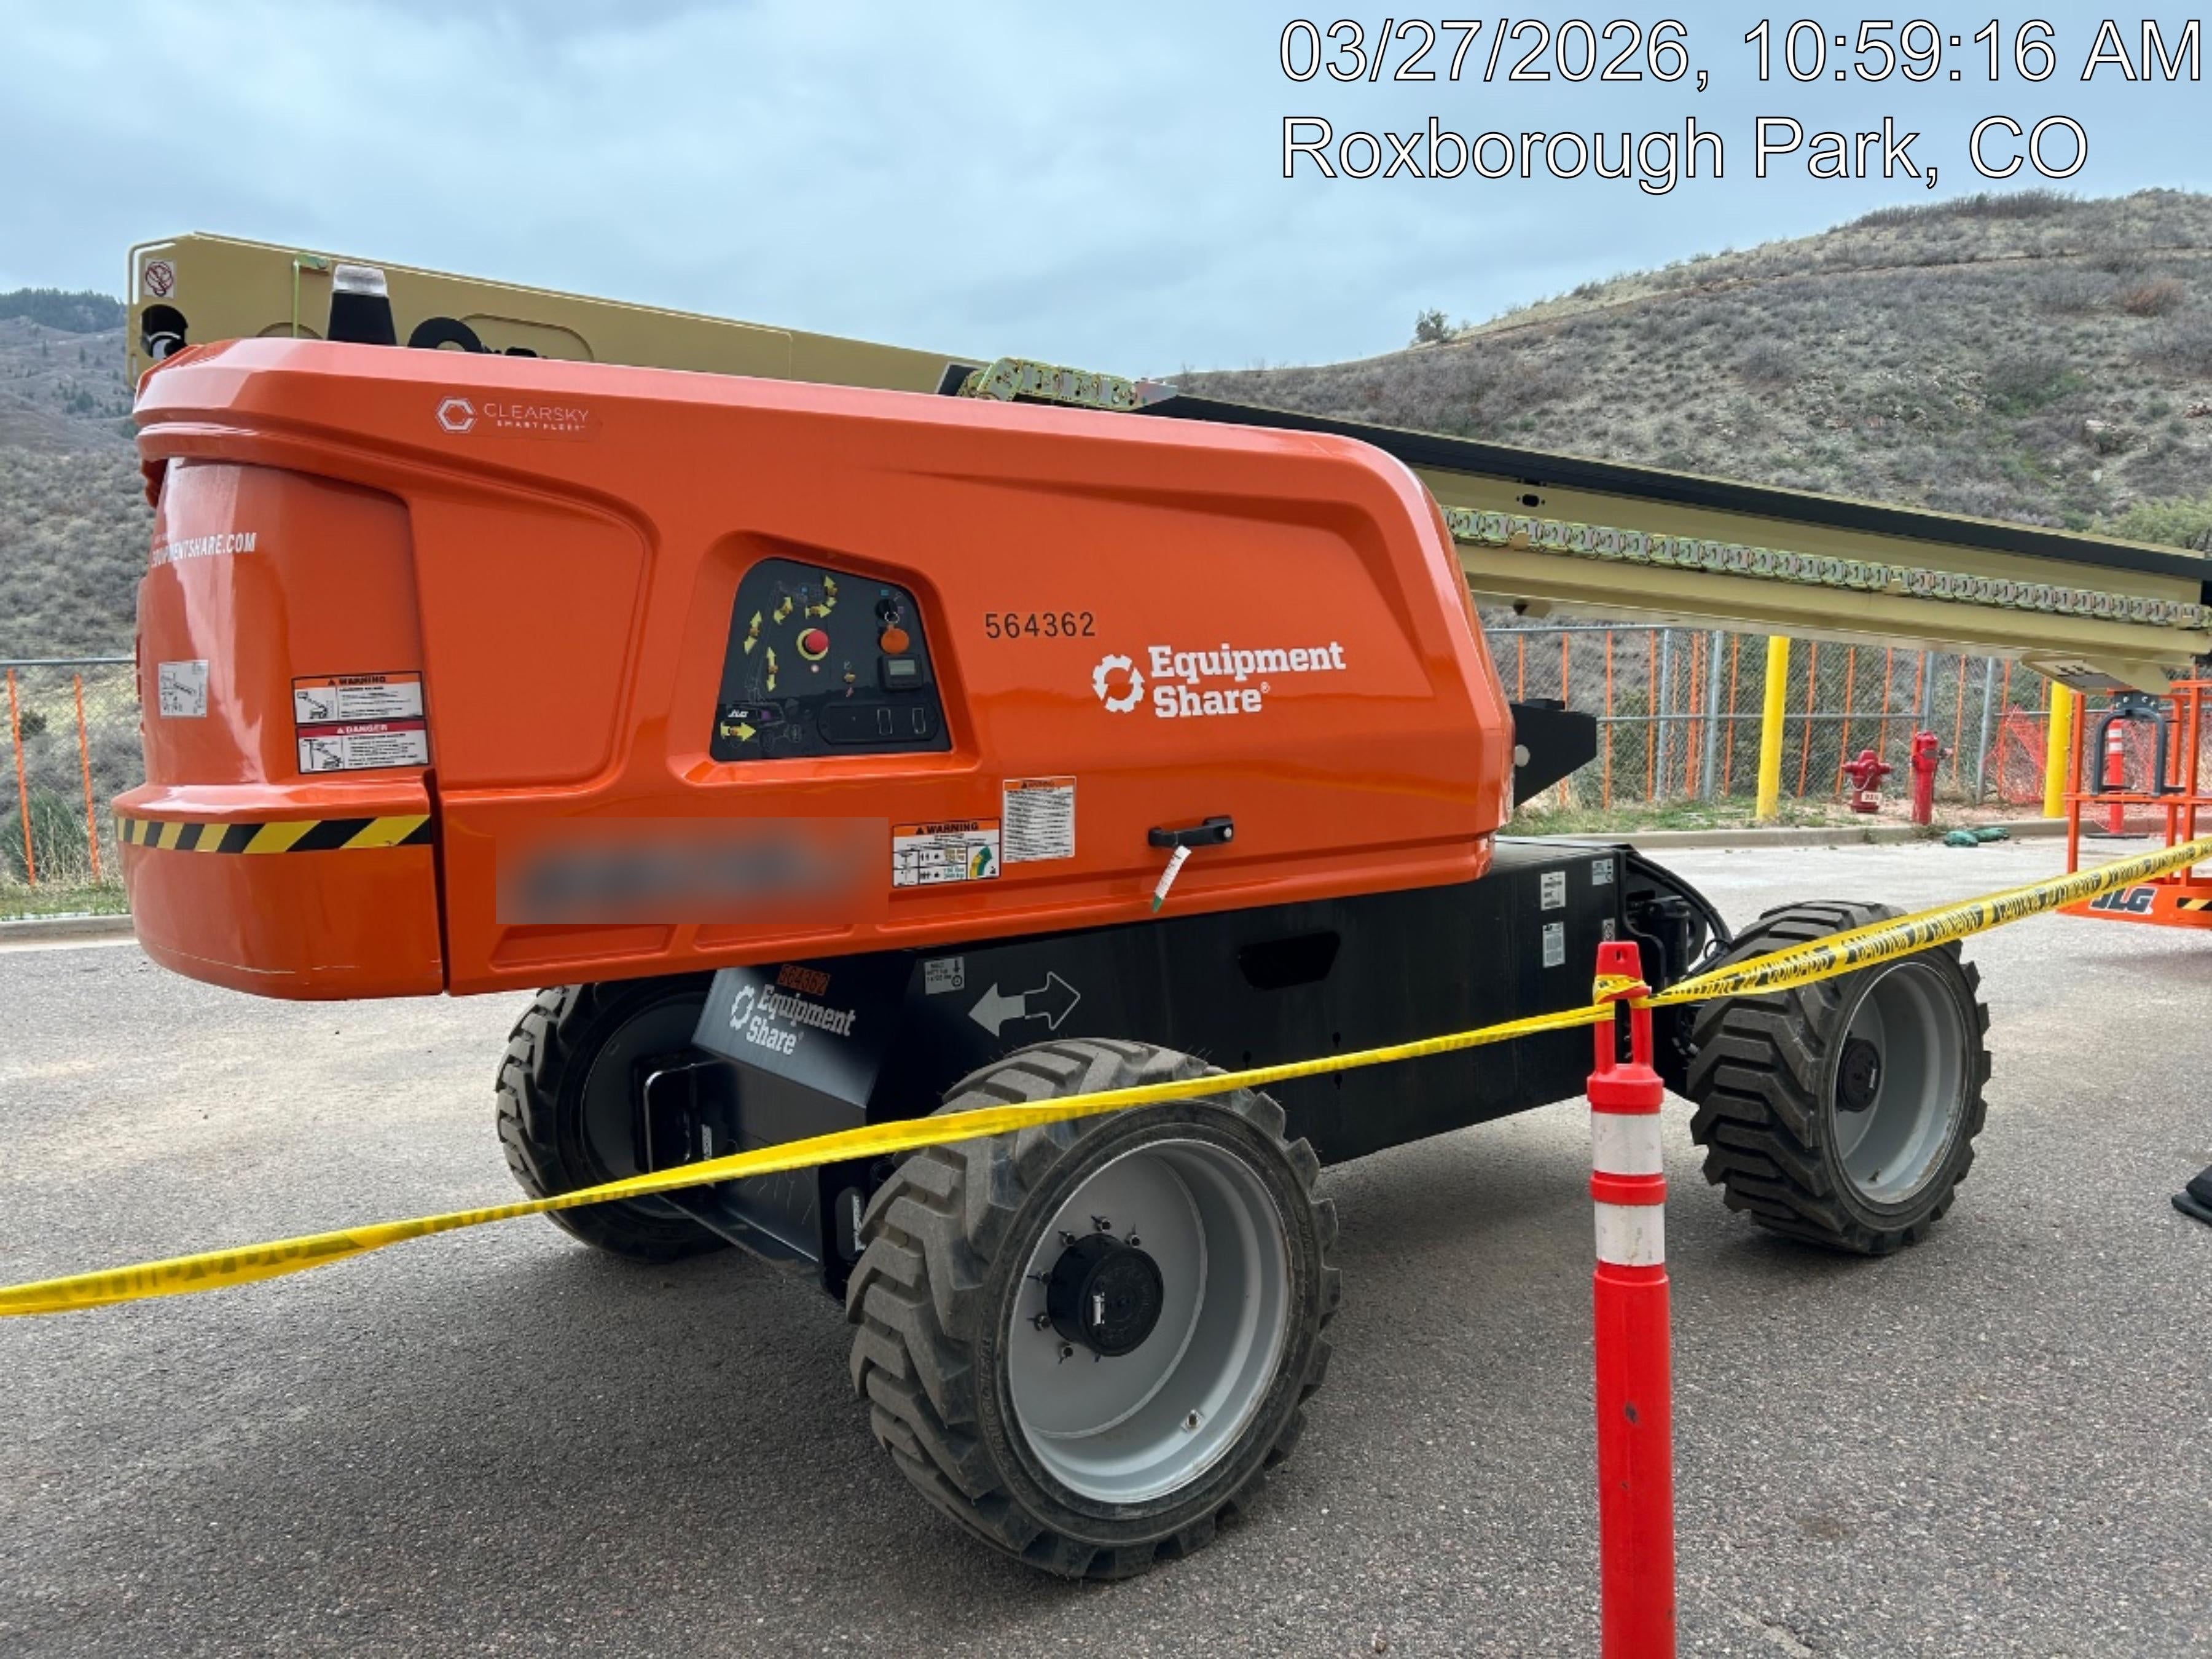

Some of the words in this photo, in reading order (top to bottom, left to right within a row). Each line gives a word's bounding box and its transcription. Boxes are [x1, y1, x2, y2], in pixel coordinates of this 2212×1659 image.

[483, 402, 589, 423] CLEARSKY
[985, 611, 1096, 638] 564362
[1148, 641, 1346, 684] Equipment
[339, 676, 386, 686] WARNING
[346, 724, 388, 734] DANGER
[927, 822, 979, 834] WARNING
[757, 984, 856, 1037] Equipment
